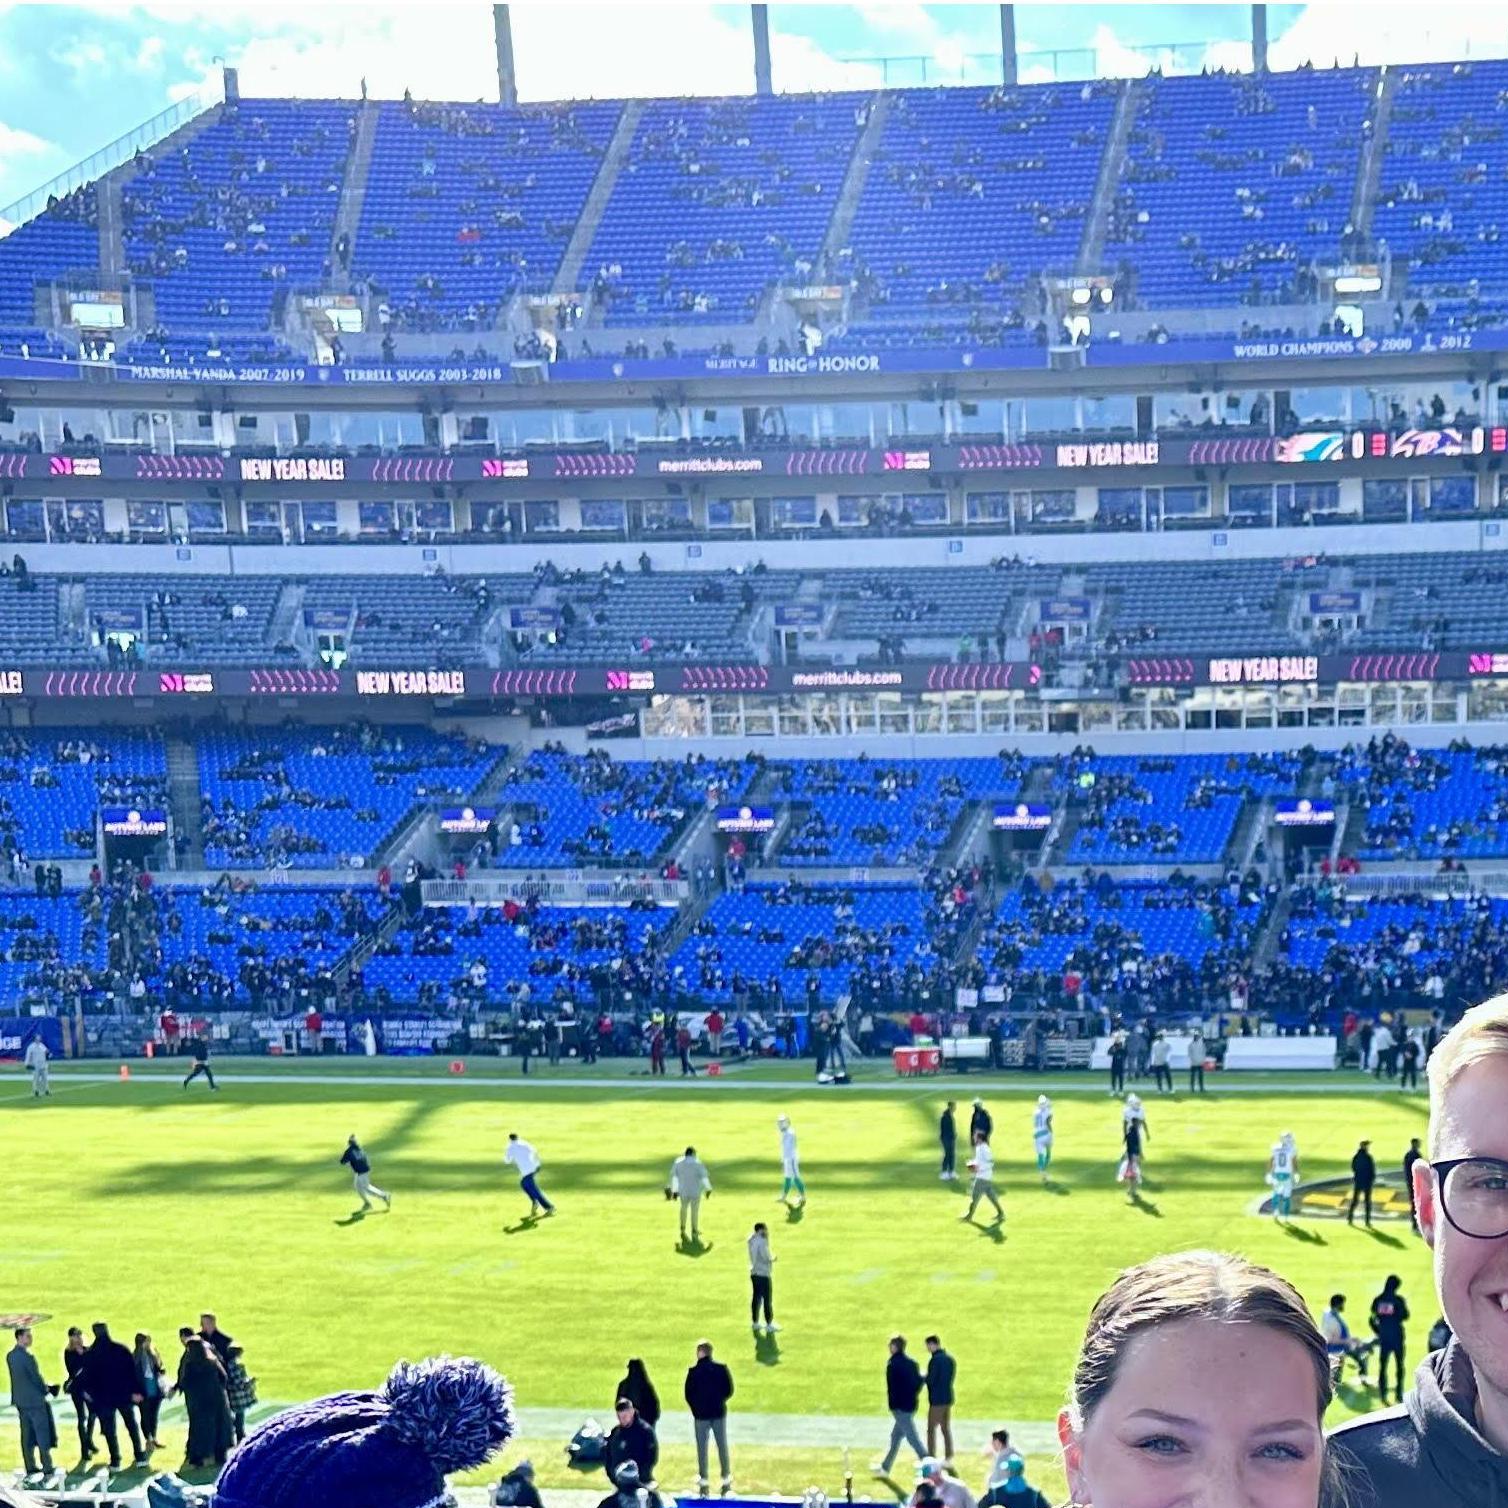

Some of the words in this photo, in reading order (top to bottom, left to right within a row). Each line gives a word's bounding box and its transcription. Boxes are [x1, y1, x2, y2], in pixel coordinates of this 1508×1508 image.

[1233, 343, 1279, 358] WORLD
[1281, 341, 1354, 356] CHAMPIONS
[768, 357, 807, 373] RING
[818, 356, 880, 372] HONOR
[193, 368, 236, 381] YANDA
[343, 368, 393, 382] TERRELL
[396, 368, 436, 382] SUGGS
[1057, 444, 1089, 467] NEW
[1089, 443, 1122, 466] YEAR
[1122, 442, 1159, 465] SALE!
[240, 458, 271, 480] NEW
[272, 458, 308, 480] YEAR
[308, 458, 345, 480] SALE!
[658, 457, 763, 473] merrittclubs.com
[1209, 658, 1243, 682] NEW
[1243, 657, 1279, 681] YEAR
[1279, 656, 1318, 680] SALE!
[356, 671, 391, 694] NEW
[391, 671, 428, 694] YEAR
[427, 671, 464, 694] SALE!
[792, 669, 902, 687] merrittclubs.com
